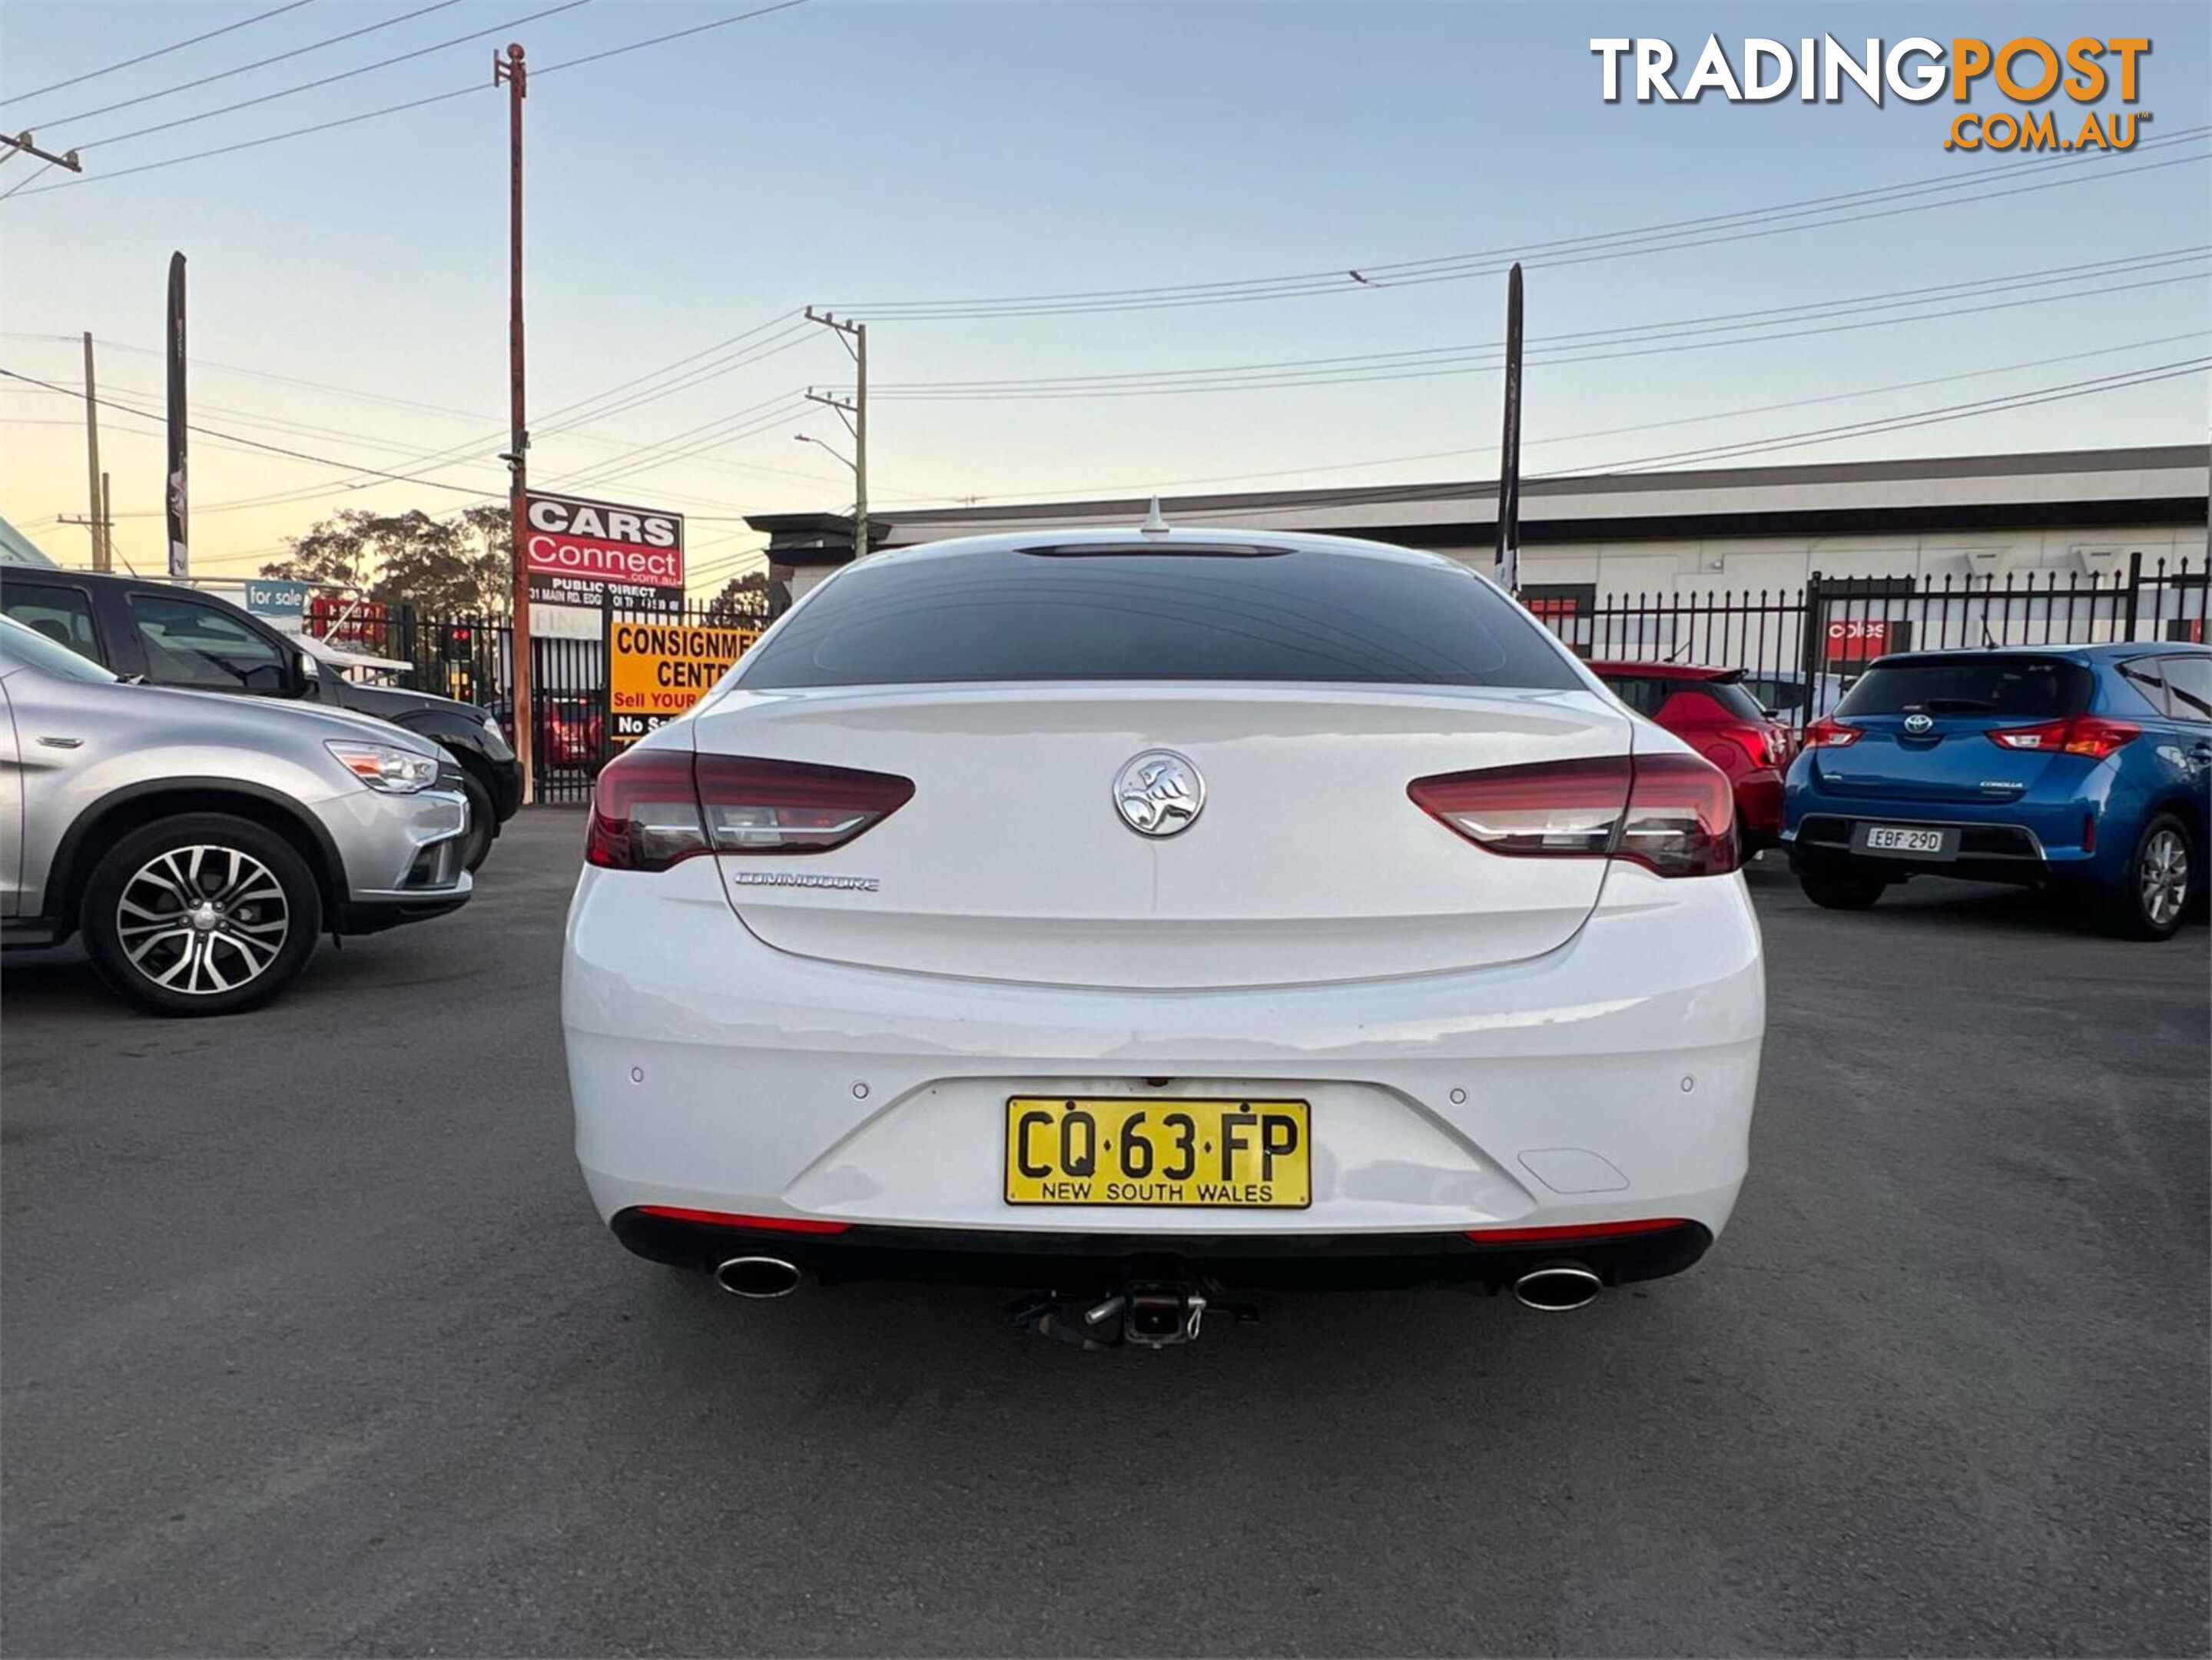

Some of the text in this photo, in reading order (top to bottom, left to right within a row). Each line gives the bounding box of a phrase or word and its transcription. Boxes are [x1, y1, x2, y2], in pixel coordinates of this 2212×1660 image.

[529, 501, 674, 546] CARS
[529, 536, 675, 576] Connect
[250, 586, 302, 606] for sale
[542, 588, 565, 602] MAIN
[552, 578, 656, 598] PUBLIC DIRECT
[1829, 621, 1884, 639] coles
[617, 627, 758, 659] CONSIGNME
[614, 692, 696, 708] Sell YOUR
[618, 716, 643, 733] No
[1875, 830, 1938, 849] EBF 29D
[735, 872, 880, 892] COMMODORE
[1043, 1183, 1273, 1203] NEW SOUTH WALES
